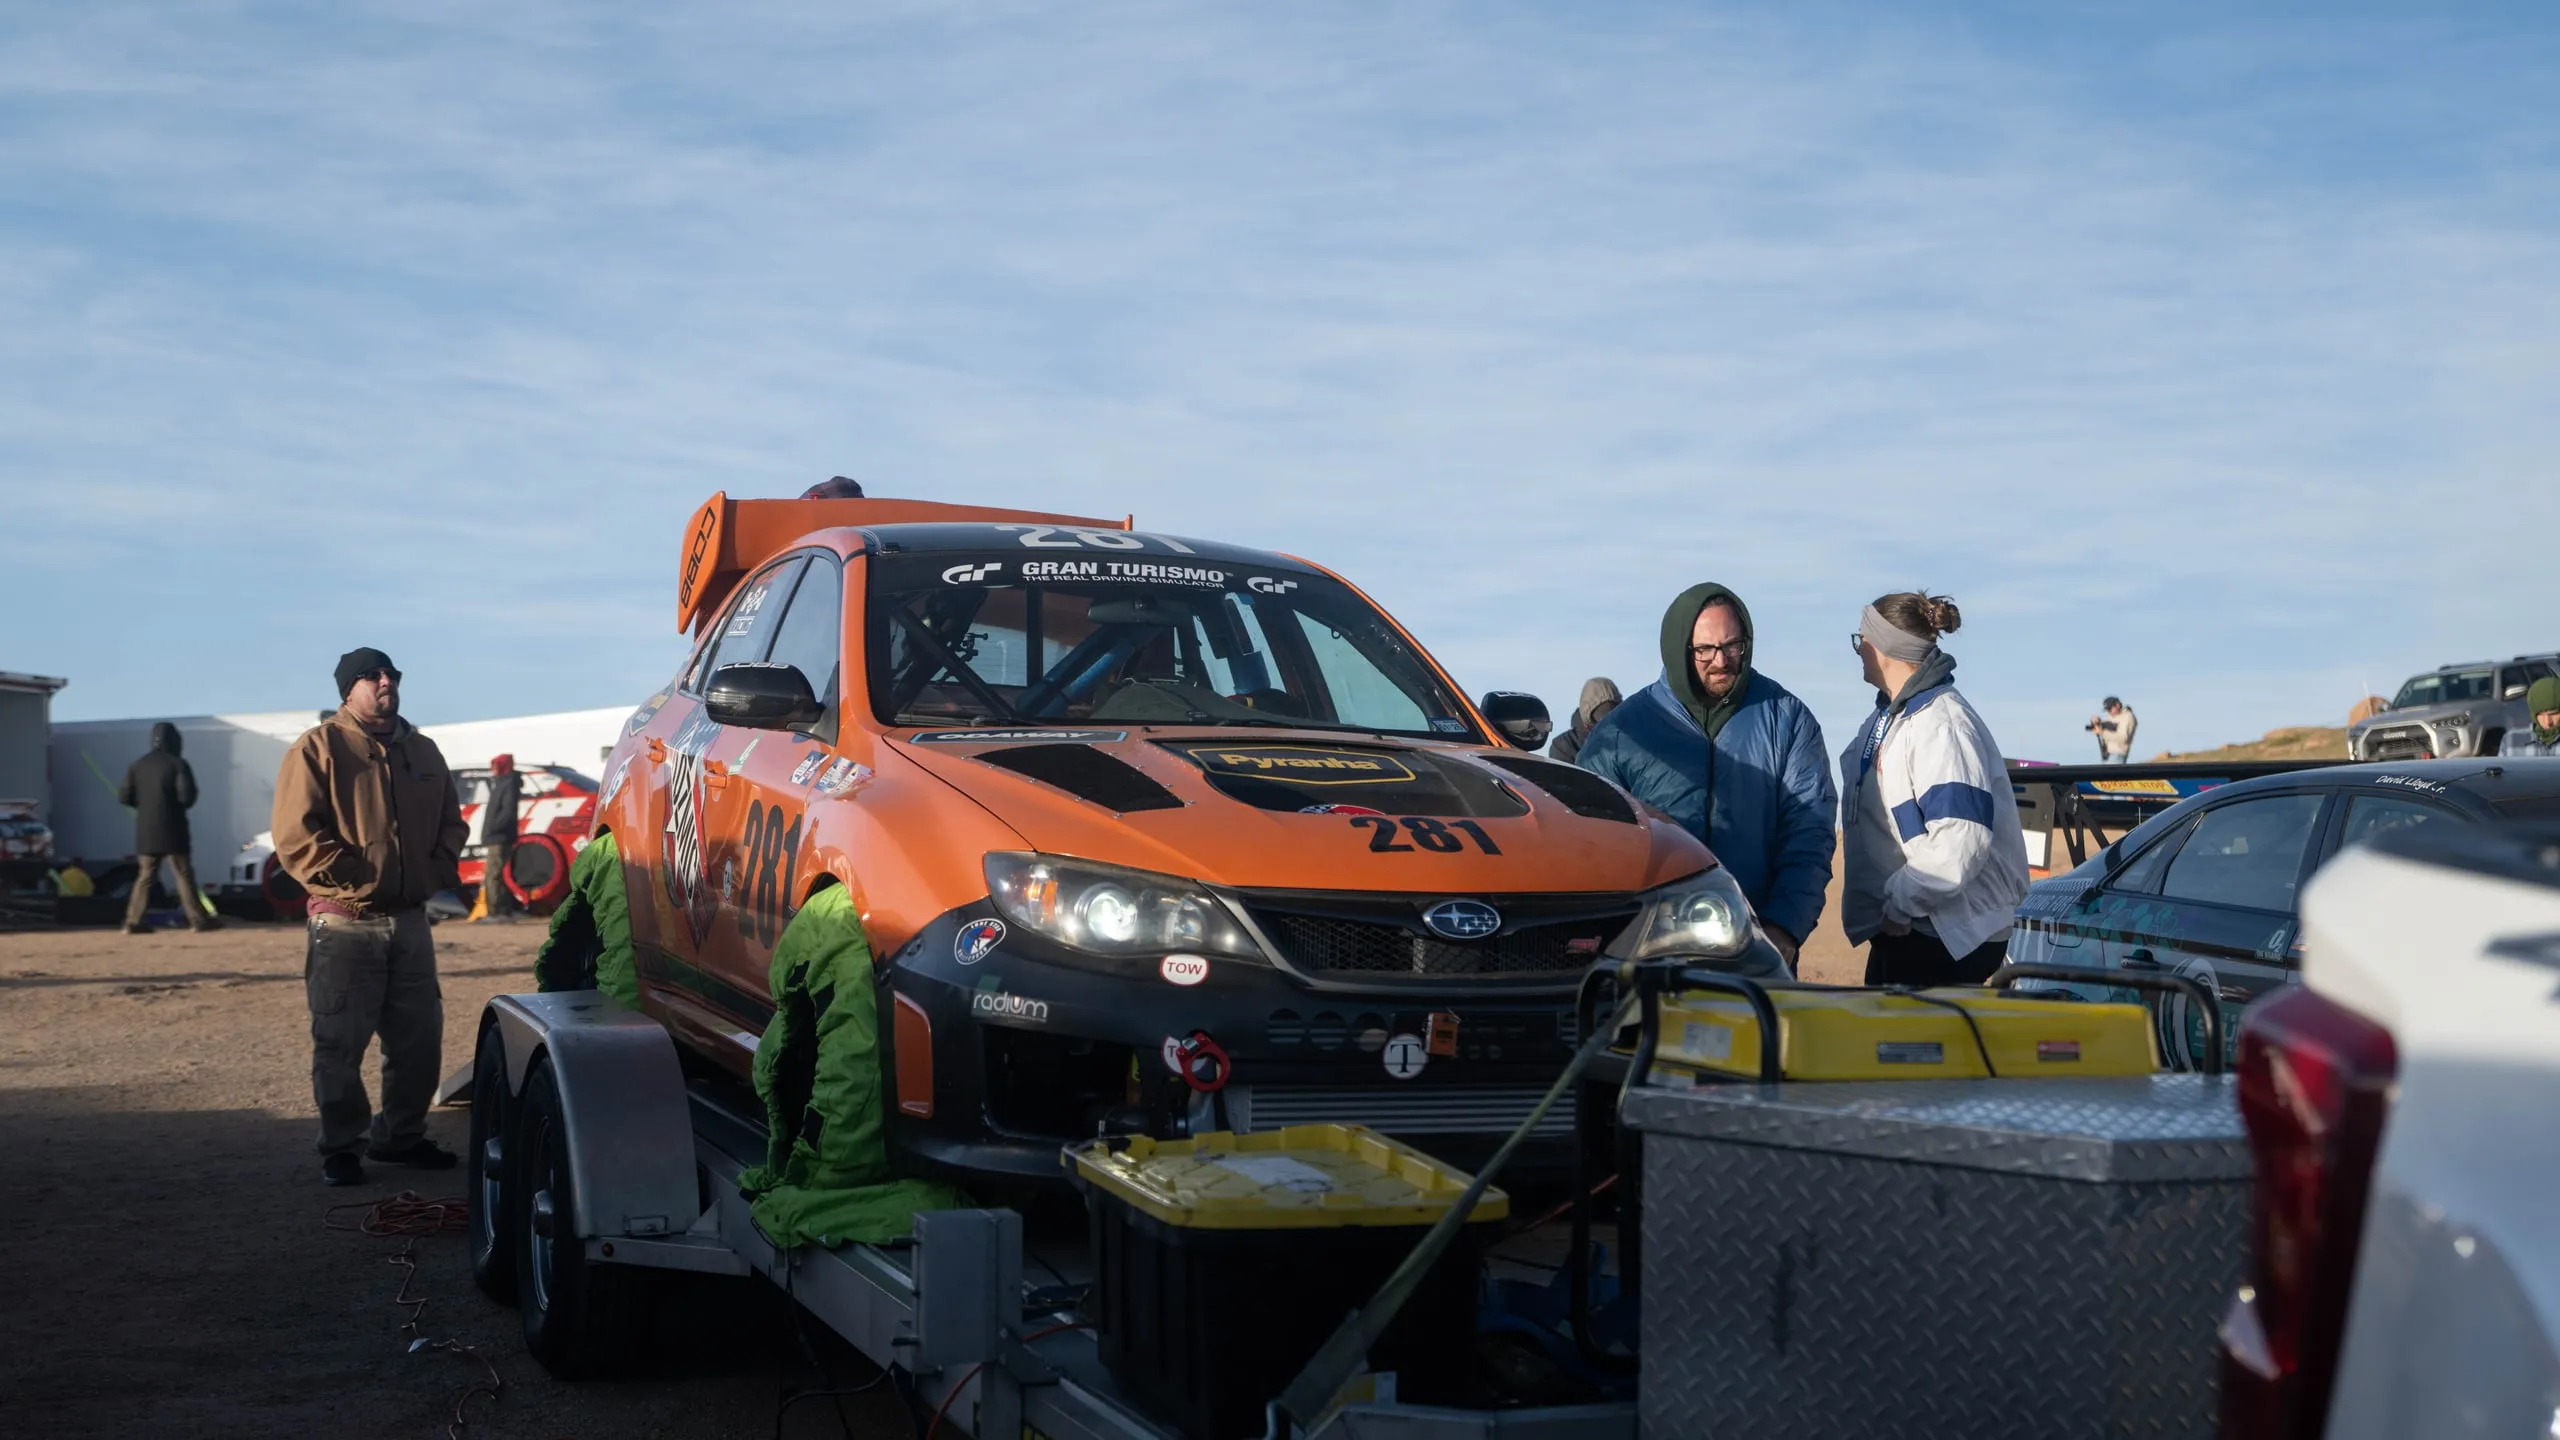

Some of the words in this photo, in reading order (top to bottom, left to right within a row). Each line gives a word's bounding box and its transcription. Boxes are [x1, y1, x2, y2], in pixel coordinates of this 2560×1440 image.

[994, 525, 1197, 555] 281
[680, 506, 716, 608] COBB
[1022, 561, 1098, 575] GRAN
[1106, 562, 1225, 583] TURISMO
[1091, 575, 1147, 583] DRIVING
[1148, 577, 1226, 590] SIMULATOR
[1219, 753, 1383, 770] Pyranha
[2375, 775, 2409, 784] David
[2405, 778, 2437, 791] Lloyd
[1350, 816, 1504, 857] 281
[738, 799, 803, 949] 281
[1167, 962, 1203, 975] TOW
[973, 991, 1048, 1018] radium
[1390, 1043, 1421, 1074] T
